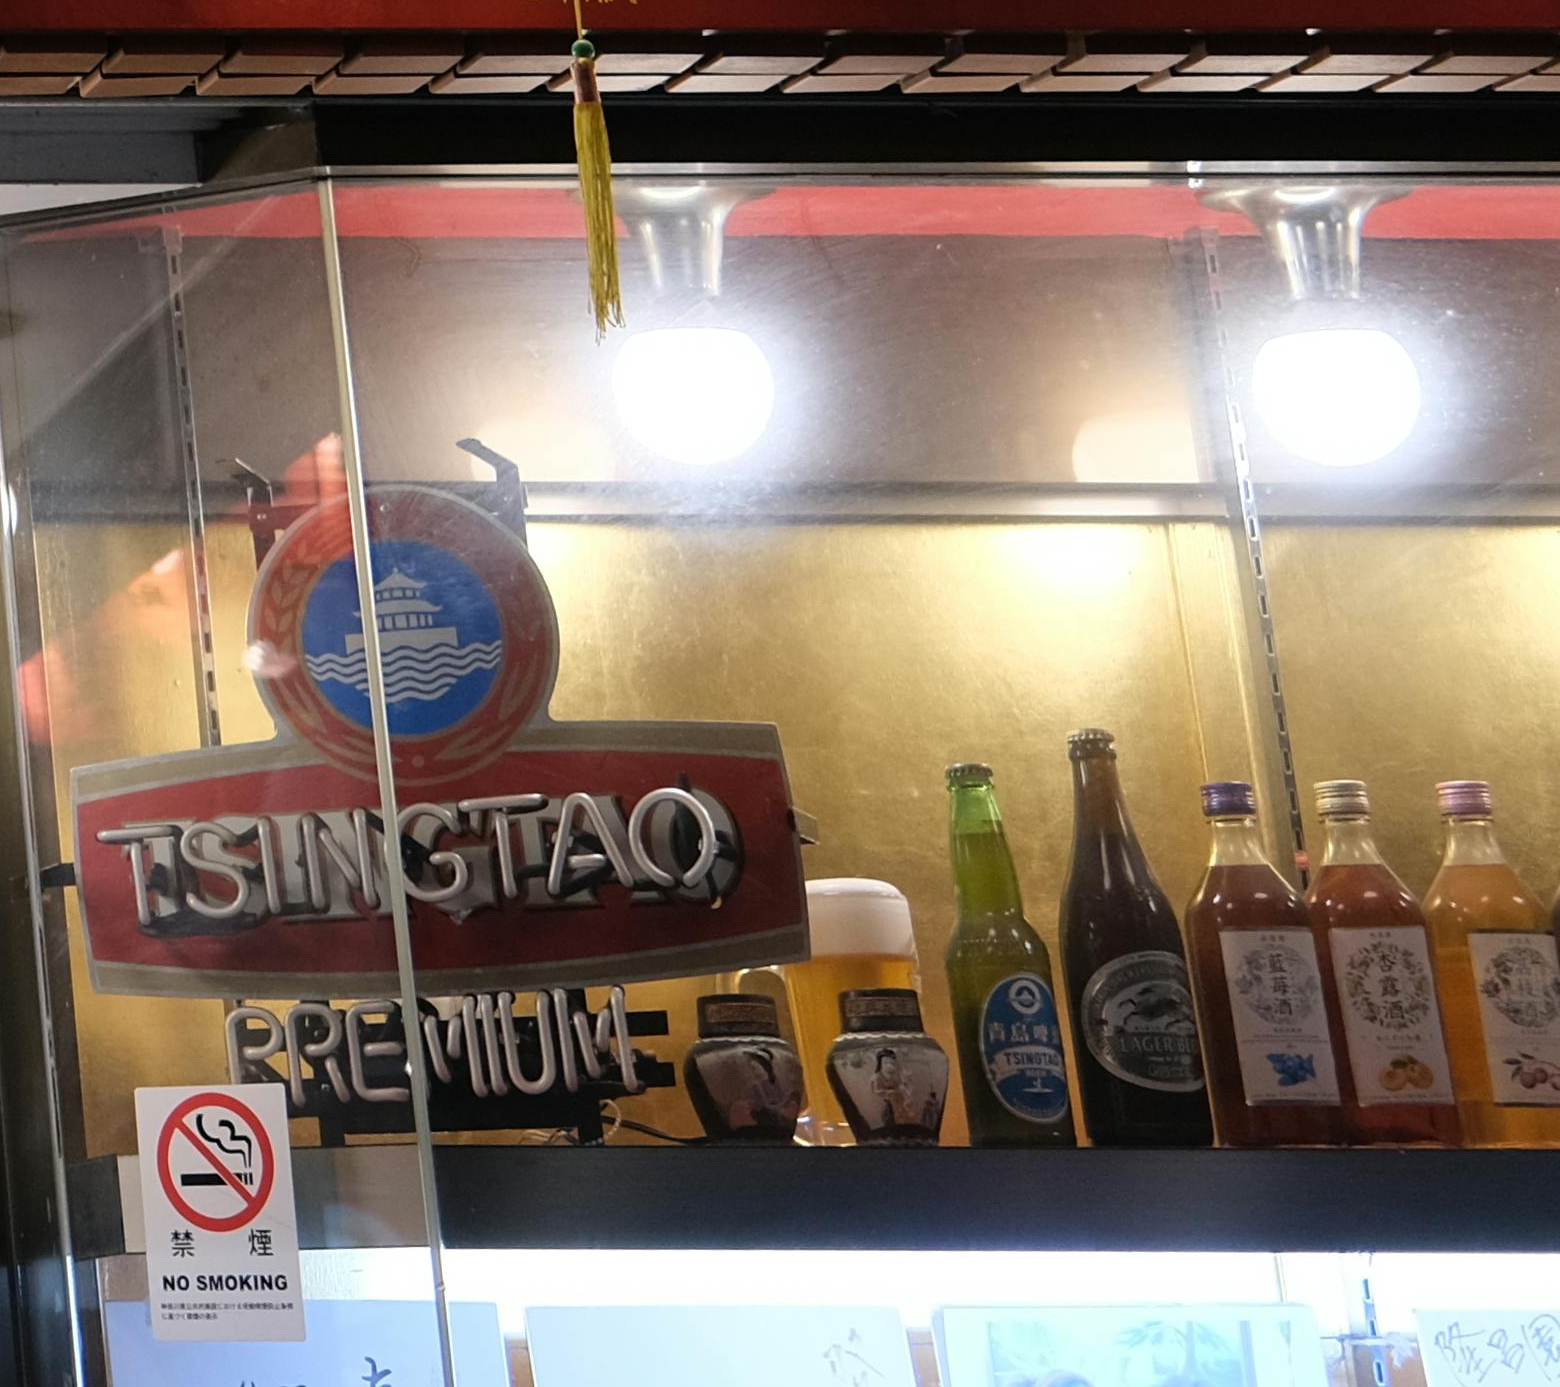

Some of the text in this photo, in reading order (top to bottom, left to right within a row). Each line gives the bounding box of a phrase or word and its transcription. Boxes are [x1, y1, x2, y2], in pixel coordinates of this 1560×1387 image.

[96, 783, 745, 935] TSINGTAO
[170, 1228, 274, 1258] 禁煙
[162, 1274, 288, 1292] NO SMOKING
